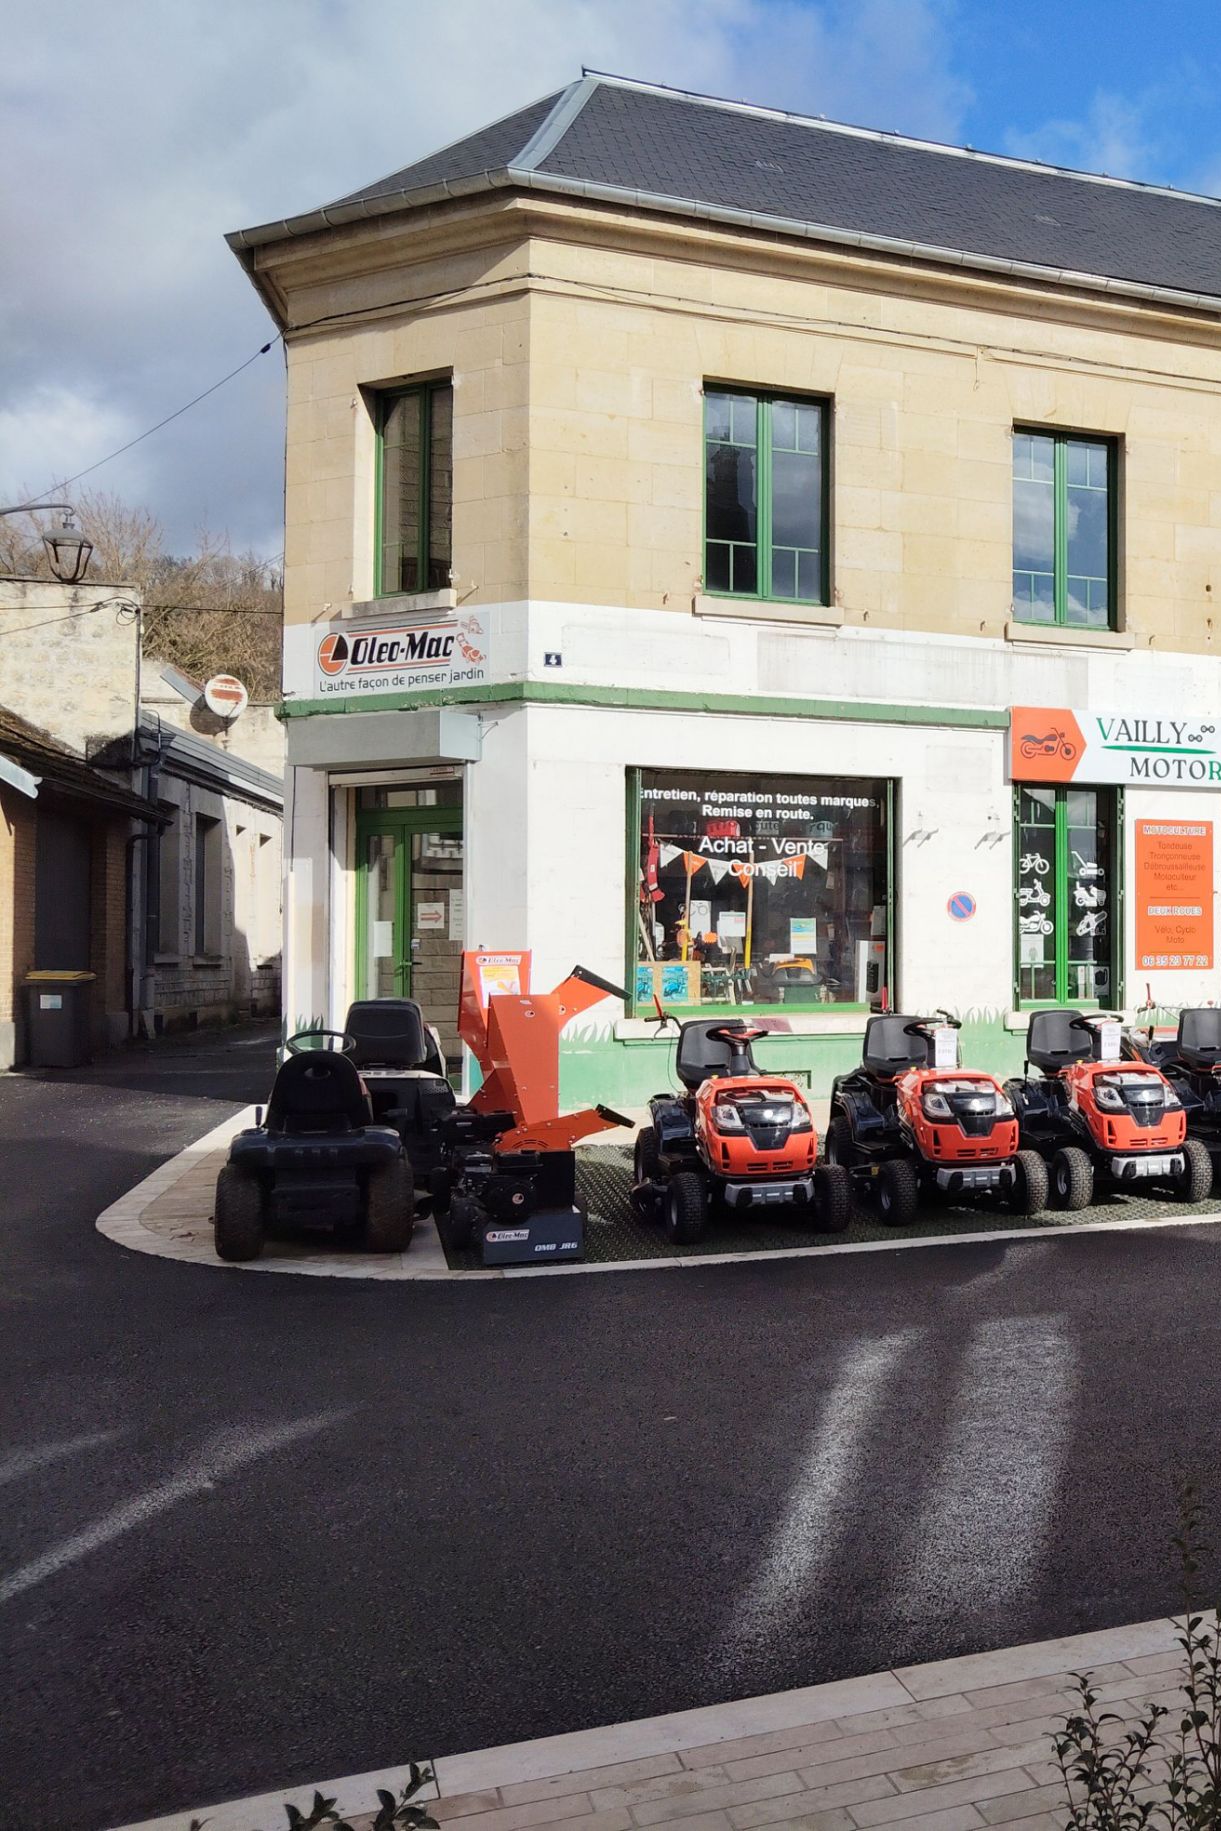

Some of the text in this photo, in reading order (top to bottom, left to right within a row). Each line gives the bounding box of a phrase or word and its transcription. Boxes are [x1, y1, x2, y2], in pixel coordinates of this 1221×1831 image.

[350, 632, 454, 665] Oleo-Mac
[549, 655, 557, 665] 4
[319, 668, 484, 692] L'autre façon de penser jardin
[1096, 717, 1187, 745] VAILLY
[704, 789, 773, 804] réparation
[776, 793, 817, 806] toutes
[820, 796, 880, 810] marques,
[702, 804, 814, 820] Remise en route.
[1143, 825, 1206, 836] MOTOCULTURE
[698, 836, 753, 854] Achat
[772, 838, 826, 855] Vente
[729, 860, 798, 878] Conseil
